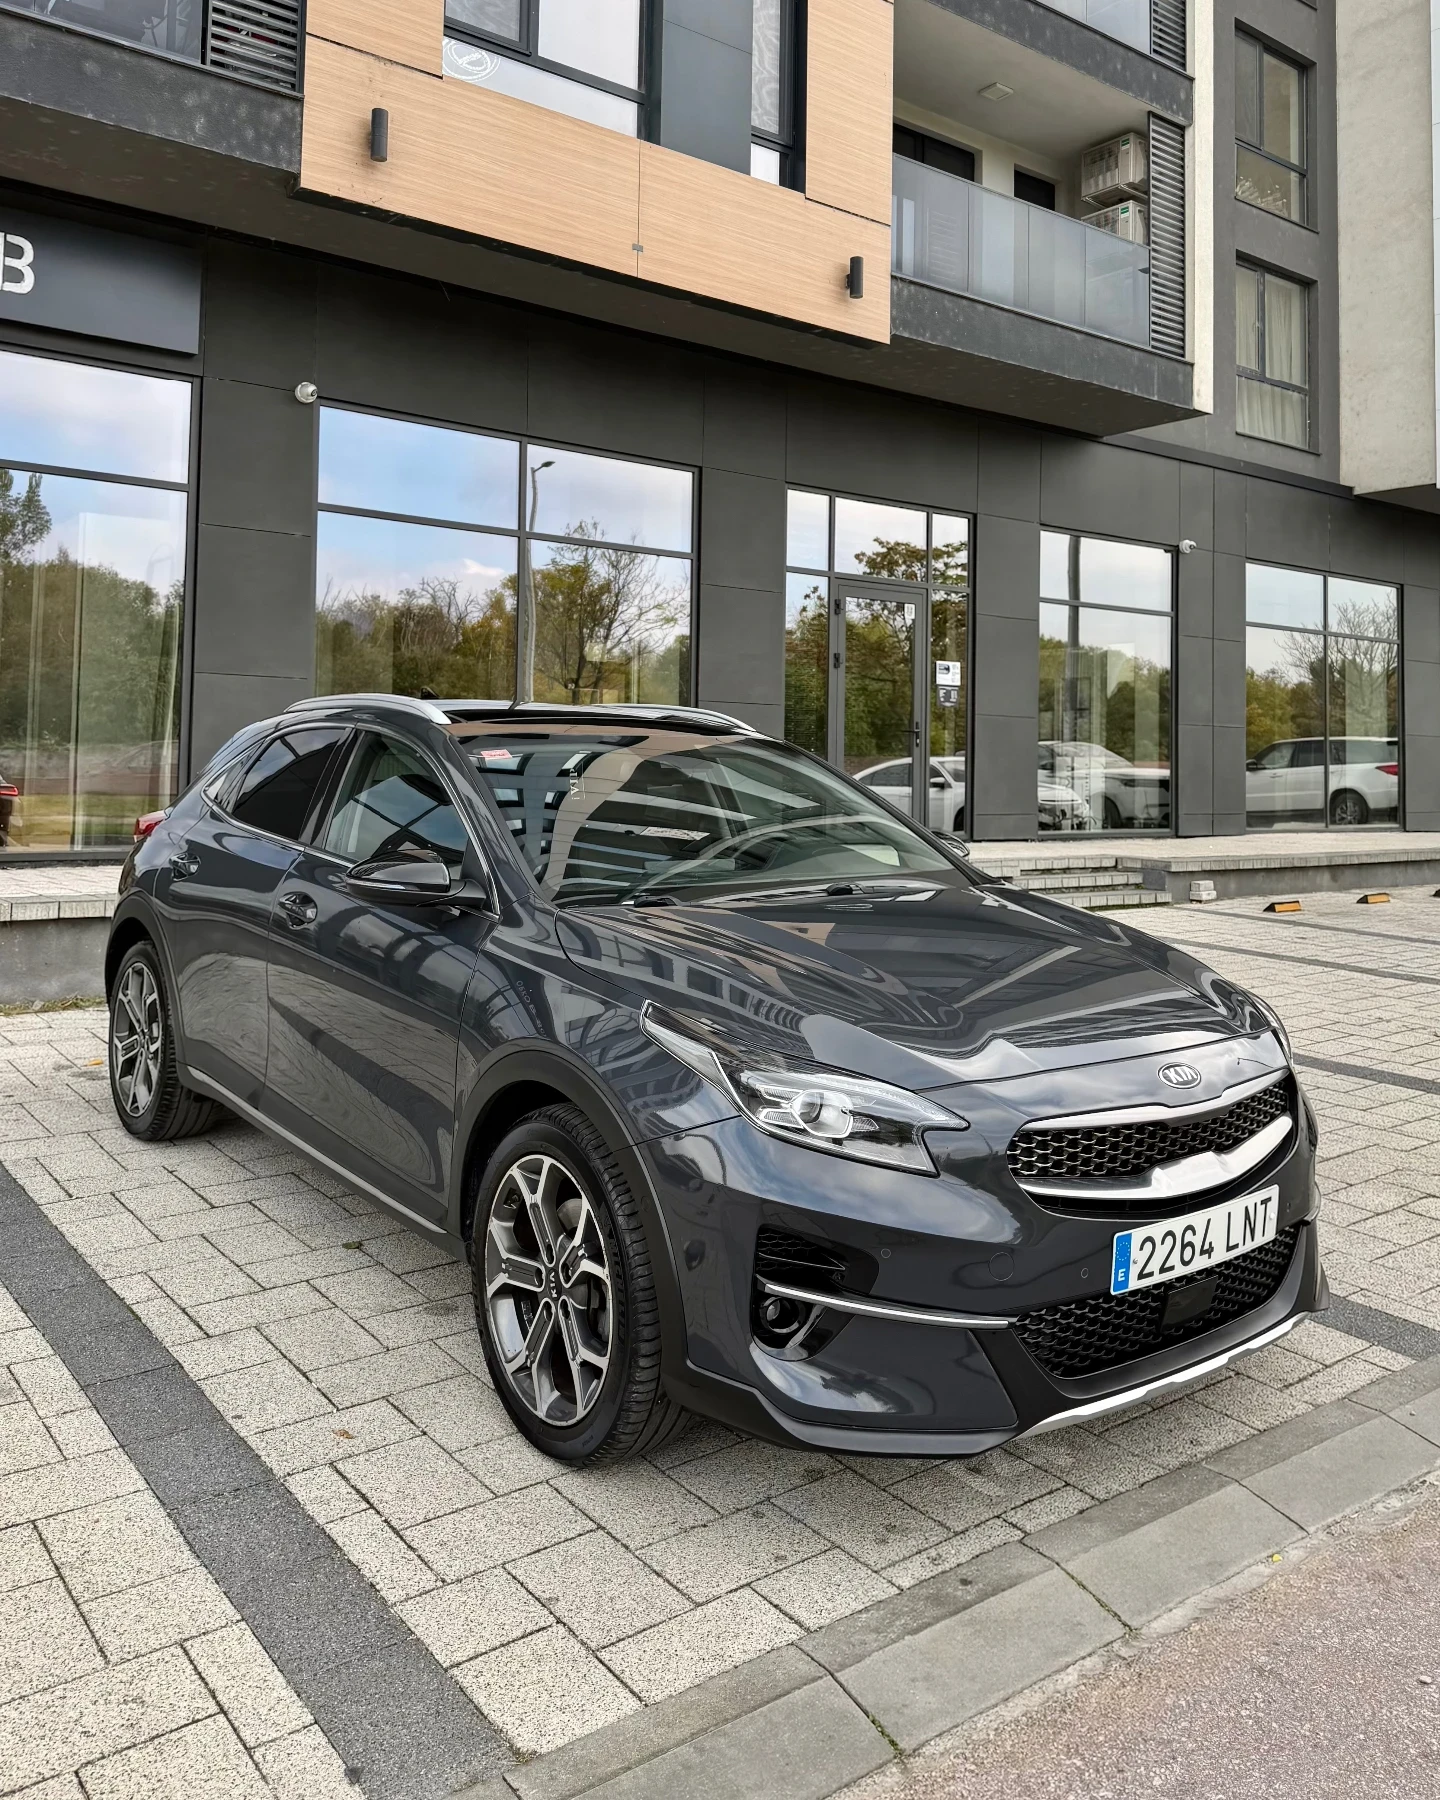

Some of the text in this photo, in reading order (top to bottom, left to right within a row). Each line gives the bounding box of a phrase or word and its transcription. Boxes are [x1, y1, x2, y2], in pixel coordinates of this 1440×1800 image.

[1163, 1066, 1198, 1084] KIA
[1136, 1196, 1272, 1281] 2264 LNT
[549, 1271, 558, 1298] KIA
[1117, 1268, 1126, 1282] E
